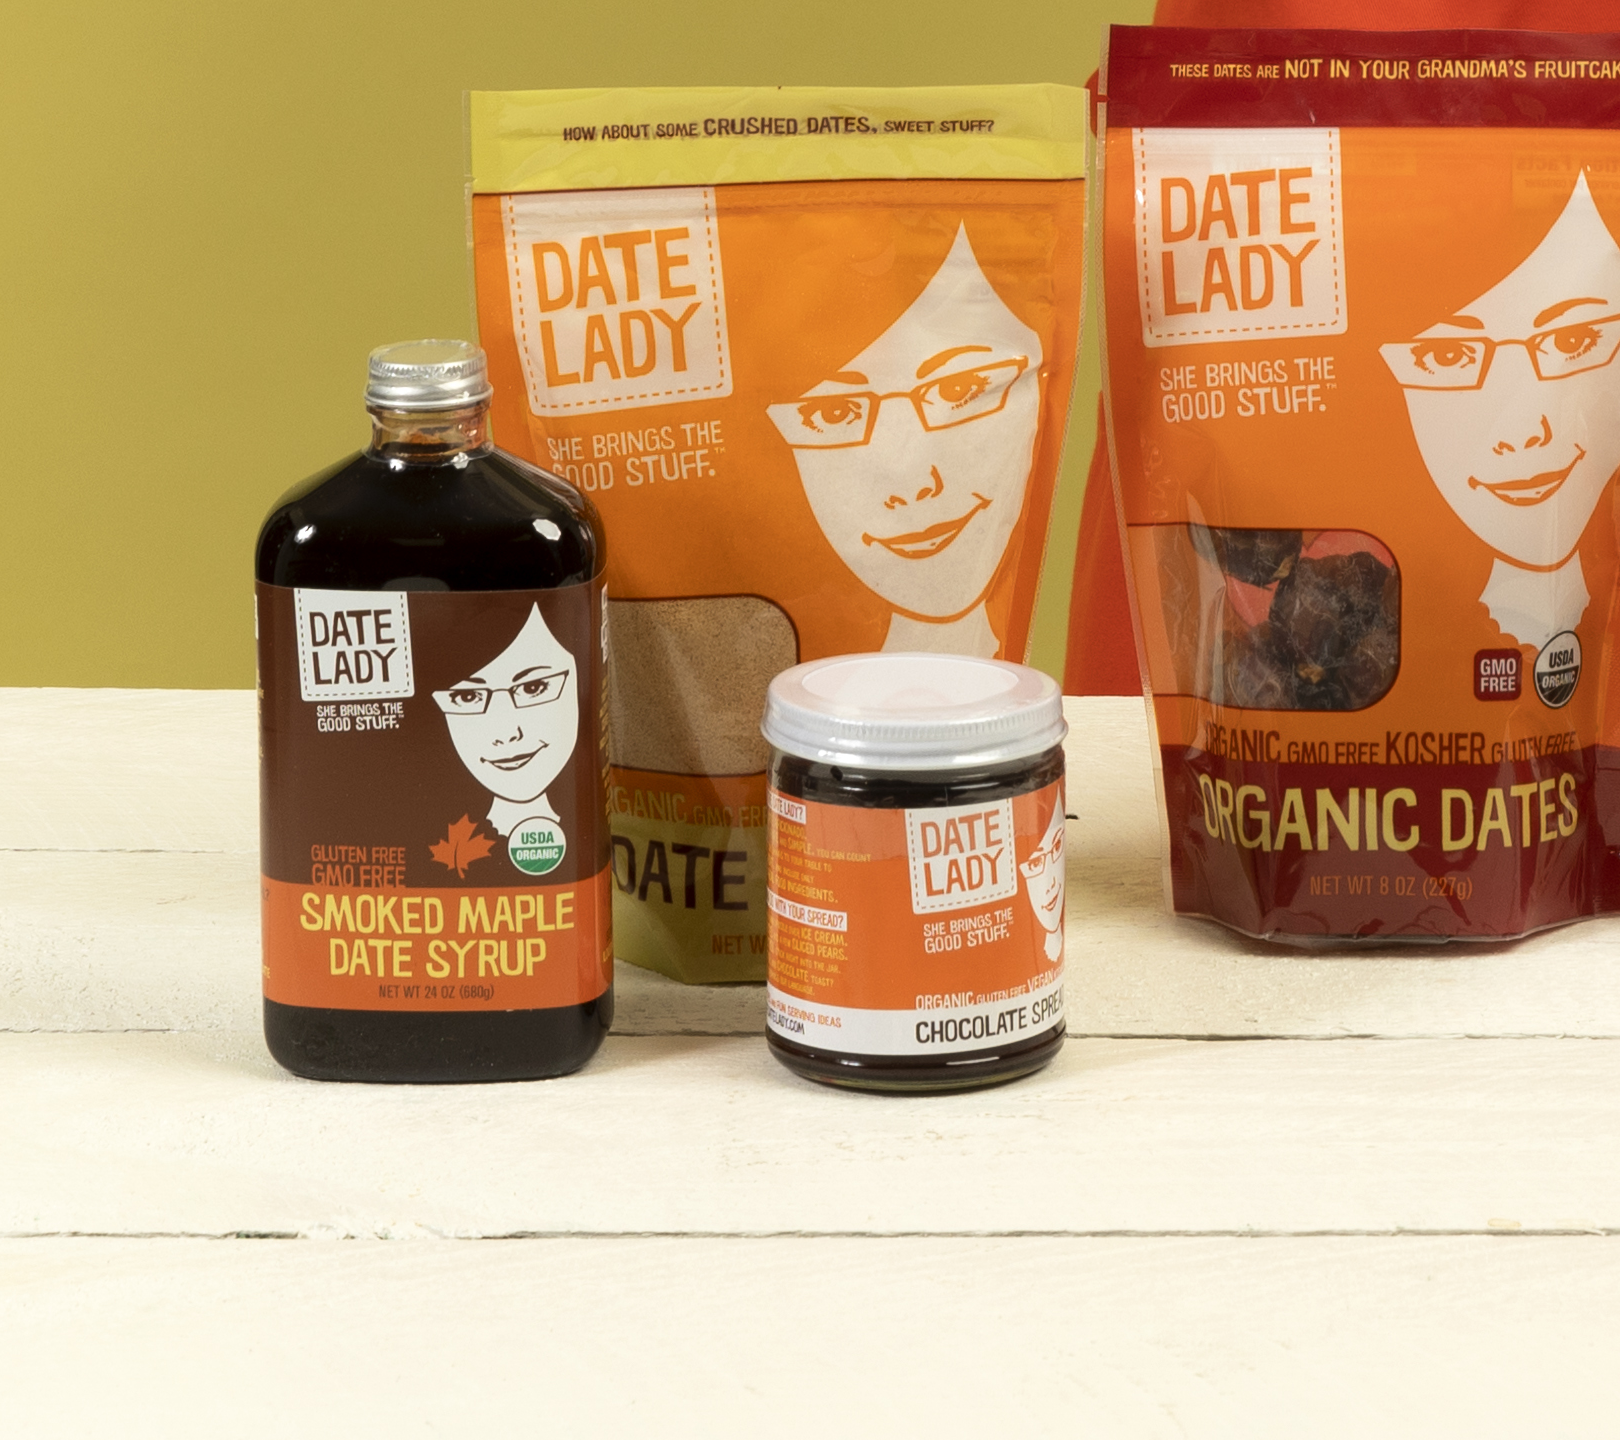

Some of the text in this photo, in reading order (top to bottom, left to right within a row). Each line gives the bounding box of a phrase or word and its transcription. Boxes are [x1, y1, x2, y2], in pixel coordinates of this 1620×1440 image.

[1170, 64, 1209, 77] THESE
[1214, 64, 1252, 78] DATES
[1257, 65, 1279, 78] ARE
[1285, 59, 1323, 78] NOT
[1330, 59, 1349, 78] IN
[1359, 60, 1409, 79] YOUR
[1418, 60, 1526, 78] GRANDMA'S
[563, 117, 994, 140] HOW ABOUT SOME CRUSHED DATES, SWEET STUFF?
[1161, 167, 1315, 244] DATE
[532, 227, 696, 313] DATE
[1161, 239, 1321, 316] LADY
[540, 302, 702, 387] LADY
[1160, 356, 1335, 391] SHE BRINGS THE
[1162, 391, 1225, 423] GOOD
[547, 421, 723, 461] SHE BRINGS THE
[309, 609, 395, 647] DATE
[312, 647, 398, 685] LADY
[1480, 658, 1516, 675] GMO
[1549, 648, 1574, 668] USDA
[1481, 677, 1516, 692] FREE
[1542, 671, 1575, 688] ORGANIC
[317, 702, 403, 717] SHE BRINGS THE
[318, 718, 350, 732] GOOD
[1207, 723, 1576, 765] ORGANIC GMO FREE KOSHER GLUTEN FREE
[611, 786, 733, 827] RGANIC GMO
[1199, 773, 1578, 852] ORGANIC DATES
[521, 831, 554, 844] USDA
[920, 809, 1002, 858] DATE
[311, 845, 406, 863] GLUTEN FREE
[516, 848, 559, 860] ORGANIC
[847, 853, 871, 862] COUNT
[312, 863, 406, 888] GMO FREE
[611, 835, 748, 910] DATE
[924, 847, 1004, 897] LADY
[1310, 876, 1472, 900] NET WT 8 OZ (227g)
[300, 892, 574, 934] SMOKED MAPLE
[789, 904, 843, 928] YOUR SPREAD?
[924, 907, 1013, 938] SHE BRINGS THE
[711, 935, 744, 954] NET
[802, 928, 811, 939] ICE
[815, 931, 847, 946] CREAM.
[924, 935, 961, 954] GOOD
[330, 938, 546, 978] DATE SYRUP
[380, 985, 494, 1000] NET WT 24 OZ (680g)
[916, 992, 973, 1010] ORGANIC
[977, 990, 1008, 1004] GLUTEN
[1010, 985, 1026, 998] FREE
[1028, 968, 1054, 991] VEGAN
[818, 1014, 841, 1027] IDEAS
[916, 986, 1064, 1044] CHOCOLATE SPREA
